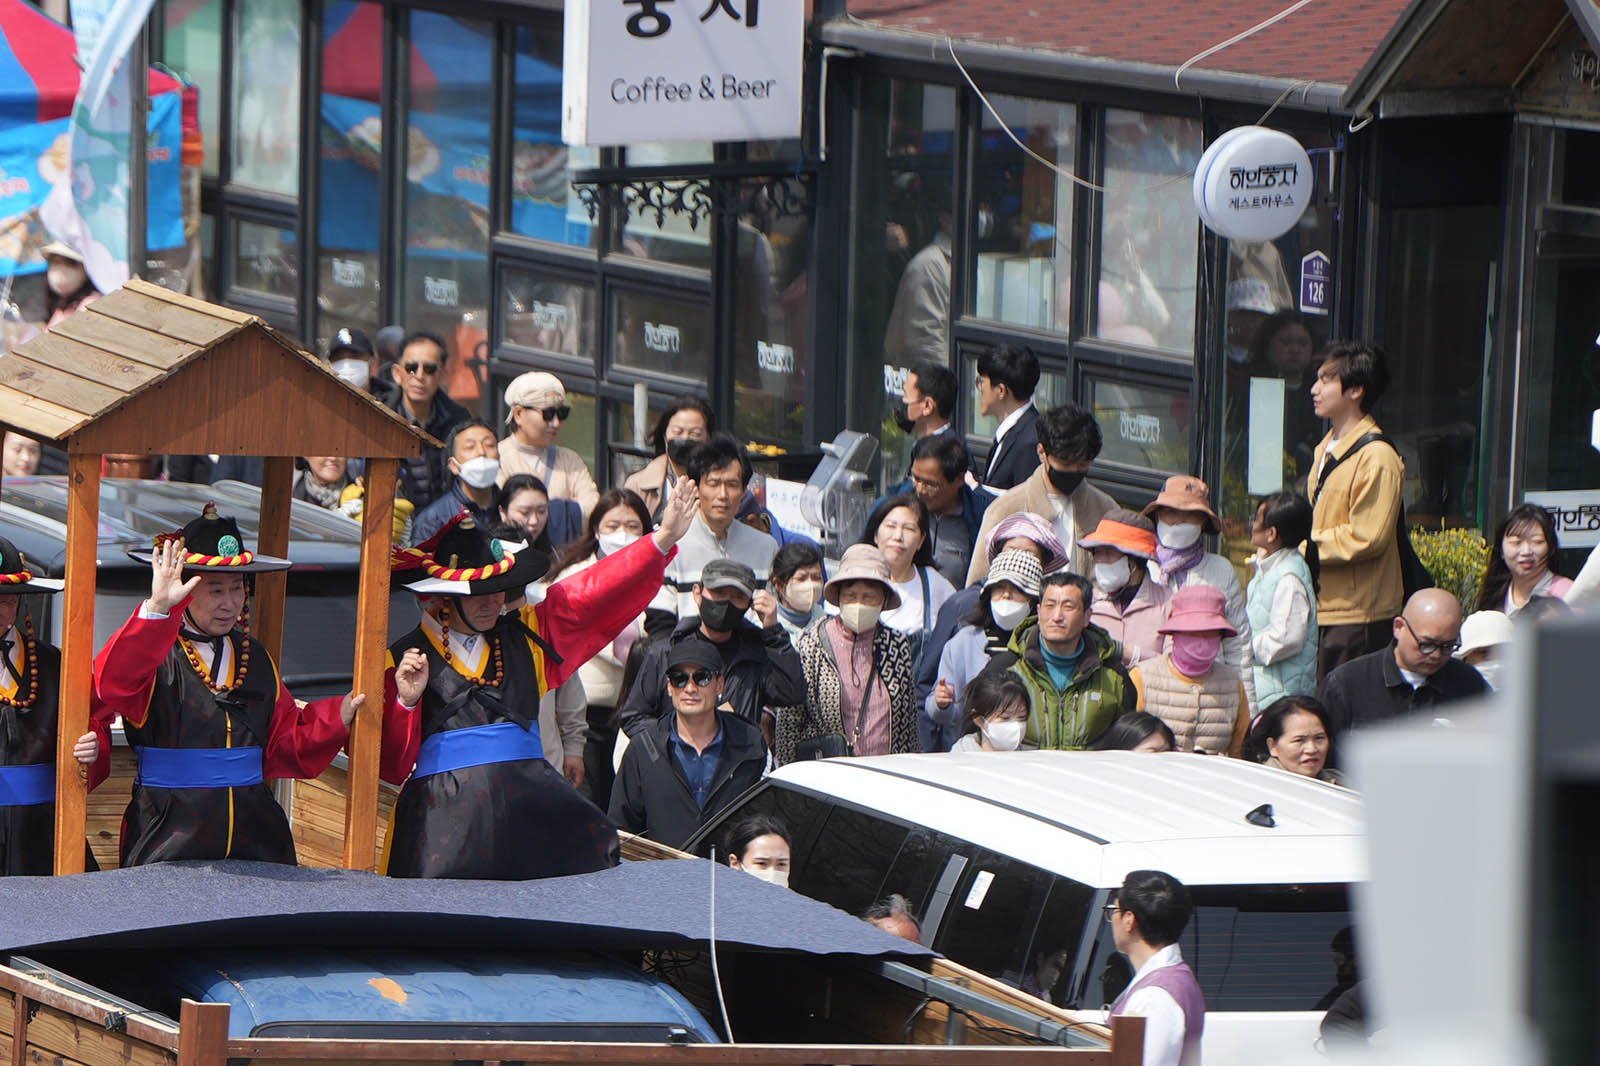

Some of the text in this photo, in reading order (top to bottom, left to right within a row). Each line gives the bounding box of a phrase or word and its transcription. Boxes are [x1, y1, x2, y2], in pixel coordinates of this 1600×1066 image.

[610, 73, 777, 104] Coffee & Beer
[1229, 194, 1295, 211] 게스트하우스
[1308, 281, 1324, 304] 126
